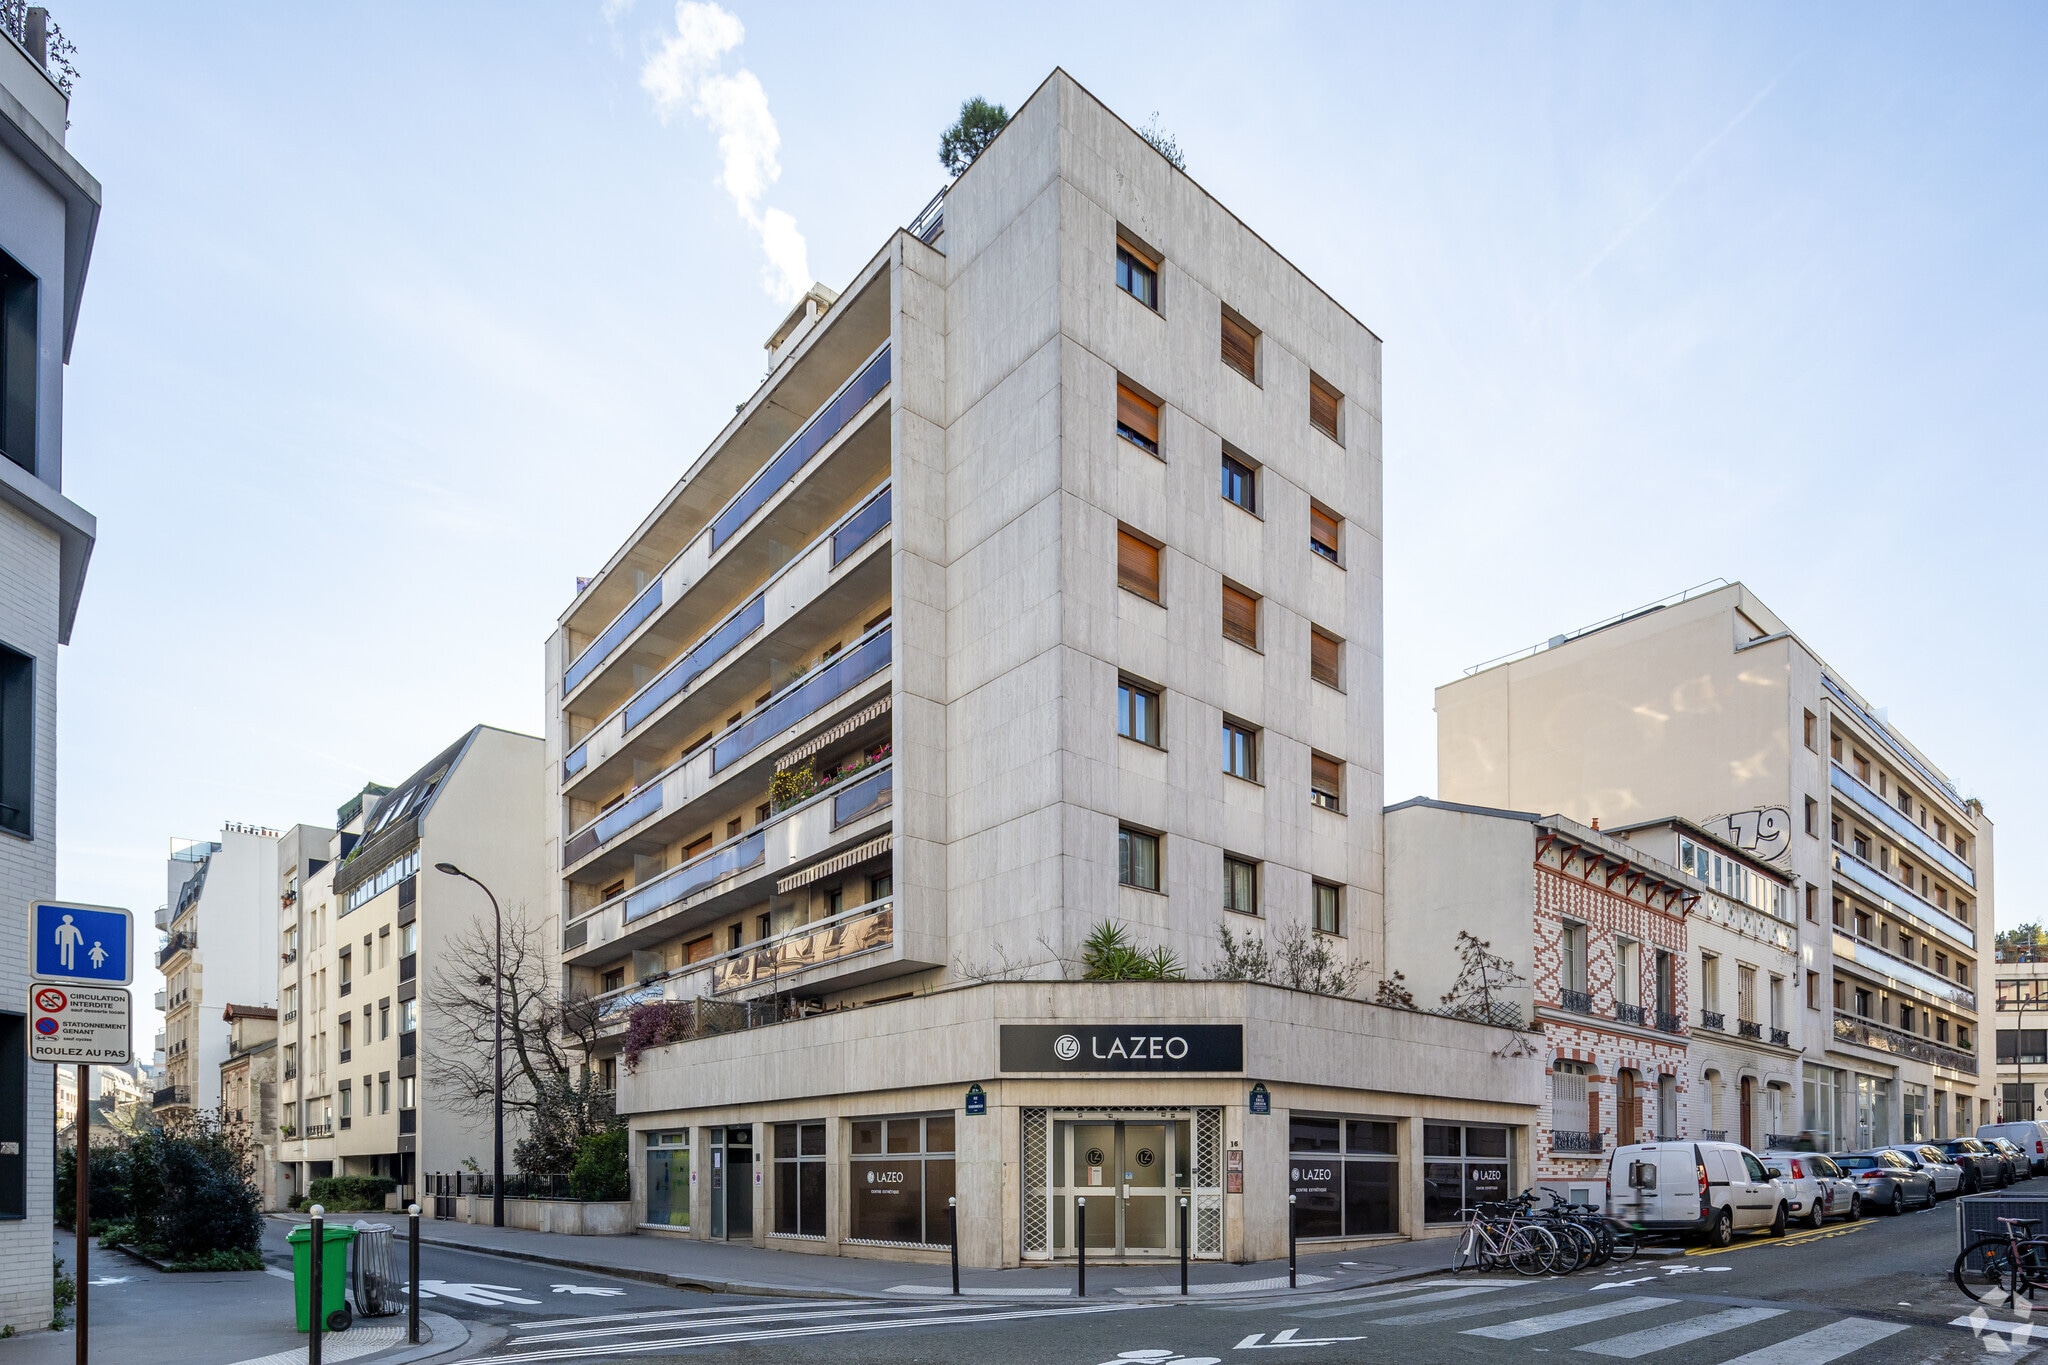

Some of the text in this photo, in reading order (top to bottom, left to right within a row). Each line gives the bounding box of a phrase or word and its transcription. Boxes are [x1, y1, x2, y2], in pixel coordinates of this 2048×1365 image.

[70, 993, 125, 1002] CIRCULATION
[70, 1001, 113, 1009] INTERDITE
[62, 1021, 127, 1029] STATIONNEMENT
[36, 1047, 83, 1056] ROULEZ
[104, 1050, 126, 1058] PAS
[1092, 1036, 1189, 1059] LAZEO
[876, 1171, 904, 1183] LAZEO
[1302, 1168, 1332, 1180] LAZEO
[1480, 1170, 1501, 1180] LAZEO
